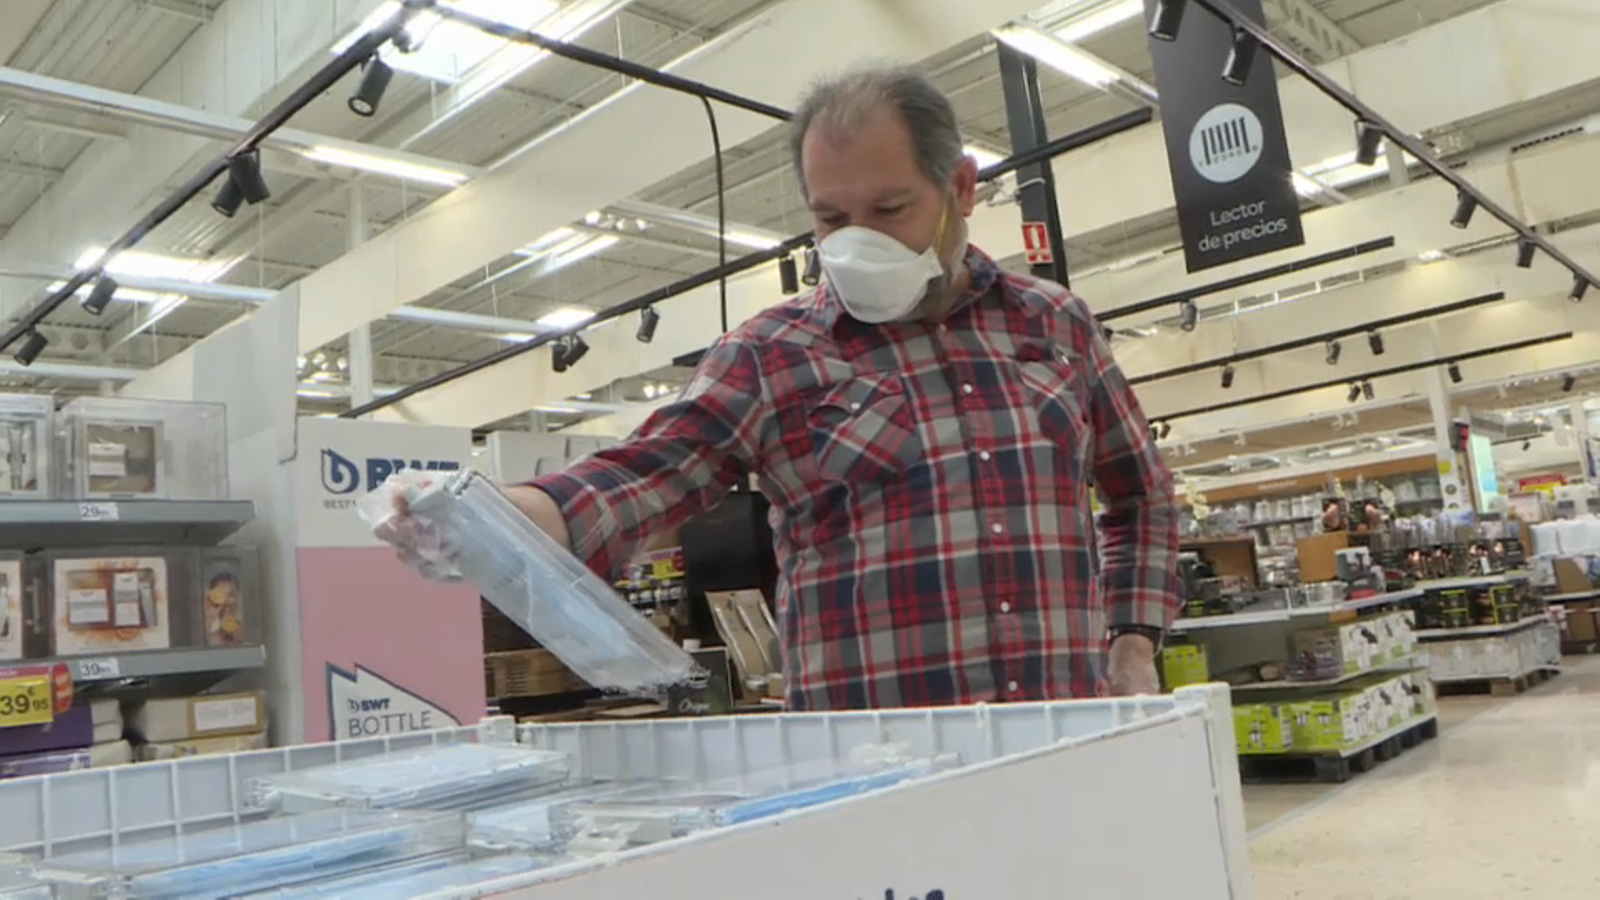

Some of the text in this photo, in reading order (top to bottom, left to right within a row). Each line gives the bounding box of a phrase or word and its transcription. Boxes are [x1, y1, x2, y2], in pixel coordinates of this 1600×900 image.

[1210, 200, 1266, 226] Lector
[1198, 218, 1288, 252] de precios
[347, 710, 433, 737] BOTTLE
